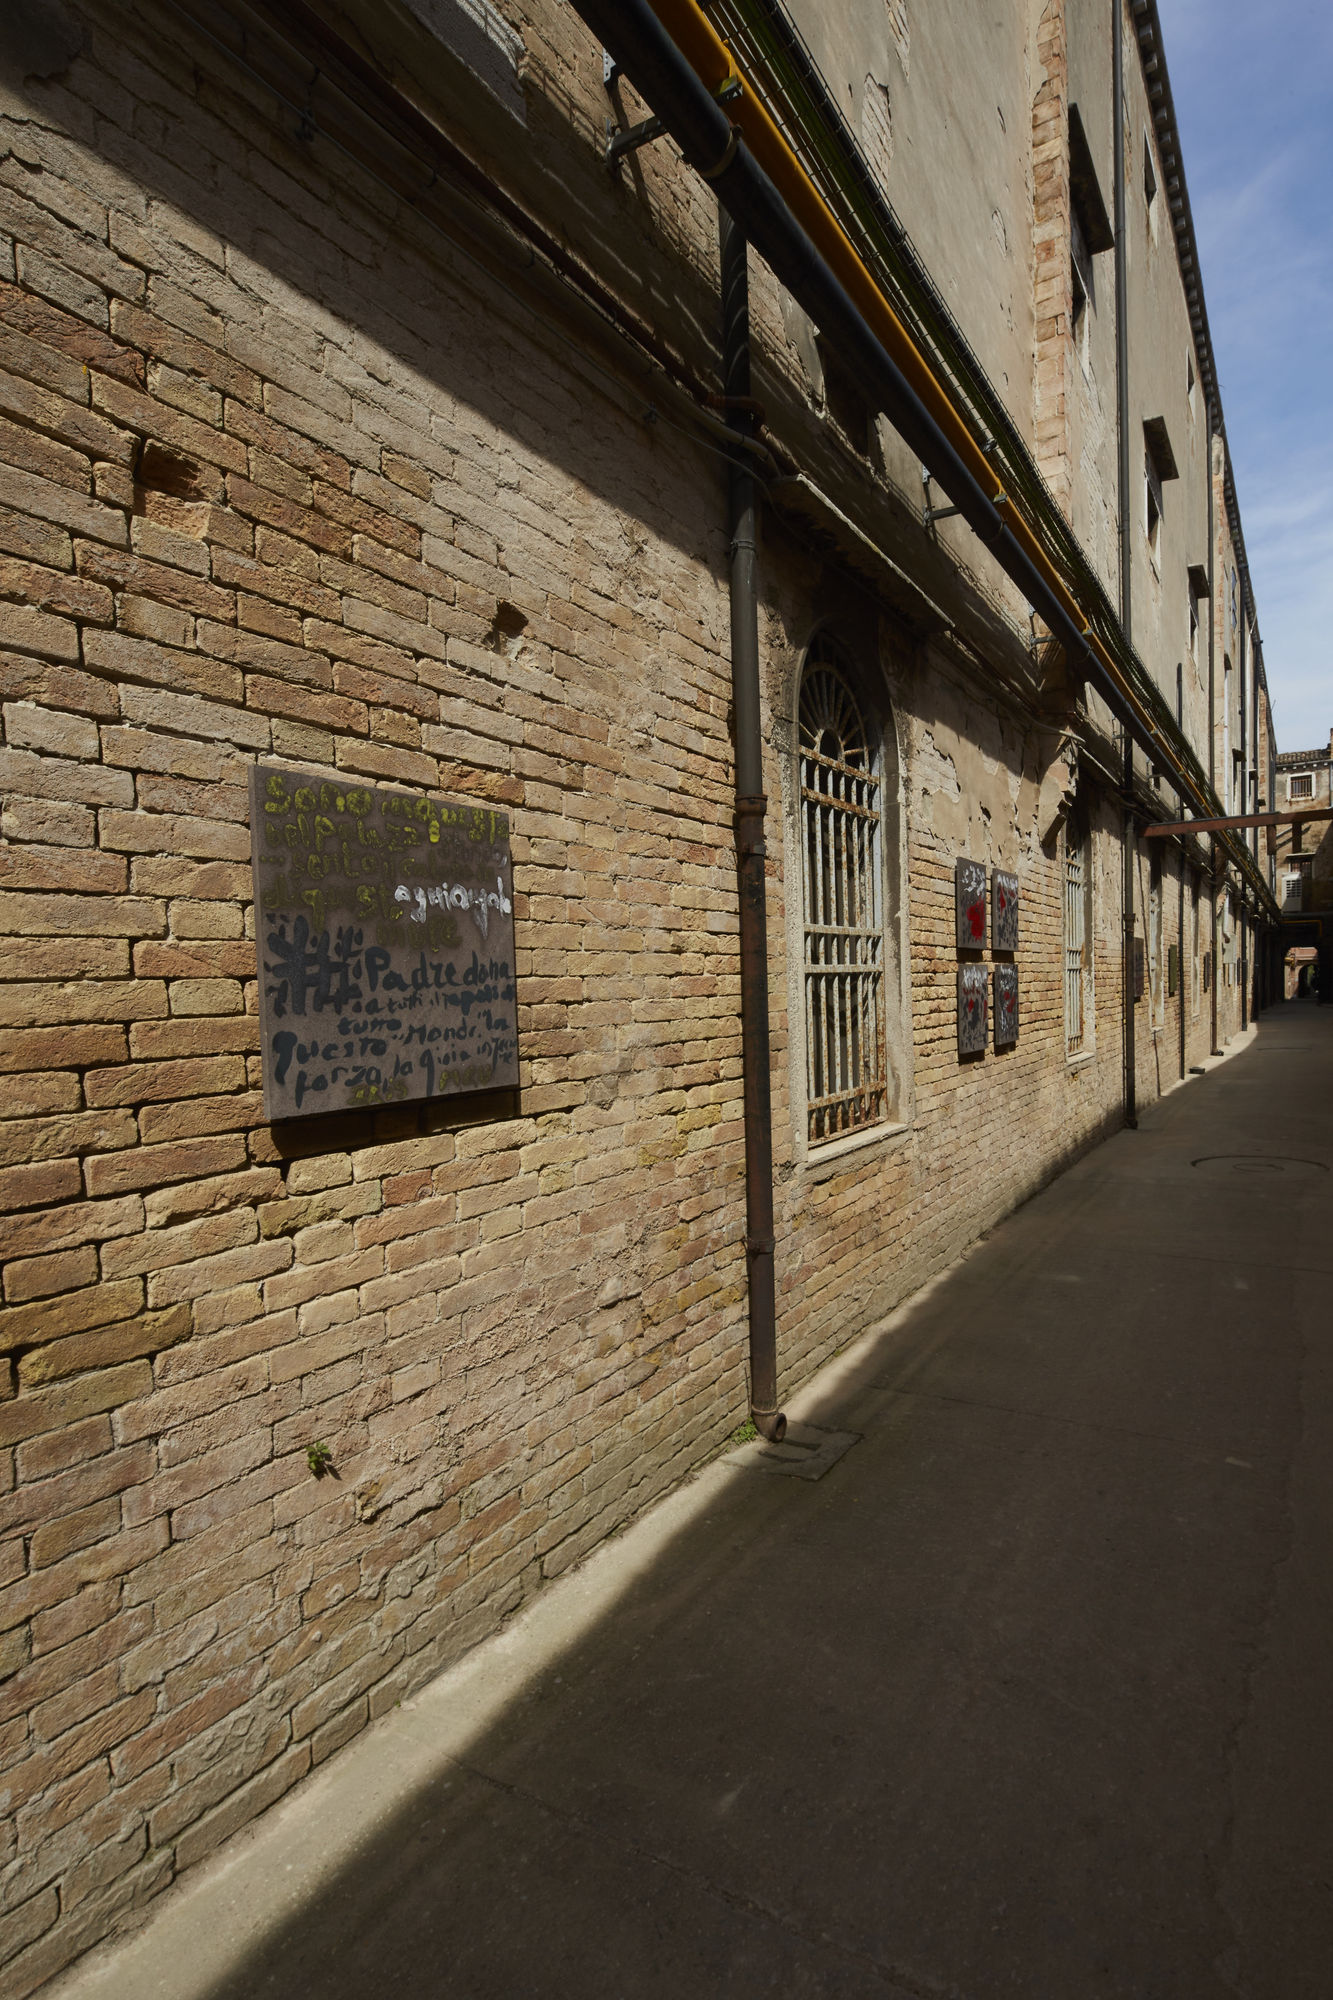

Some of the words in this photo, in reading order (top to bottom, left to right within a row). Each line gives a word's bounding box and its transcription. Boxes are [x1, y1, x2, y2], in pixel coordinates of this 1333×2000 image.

[264, 776, 373, 816] Sono
[365, 946, 464, 992] Padre
[463, 951, 516, 985] dona
[394, 1054, 413, 1077] la
